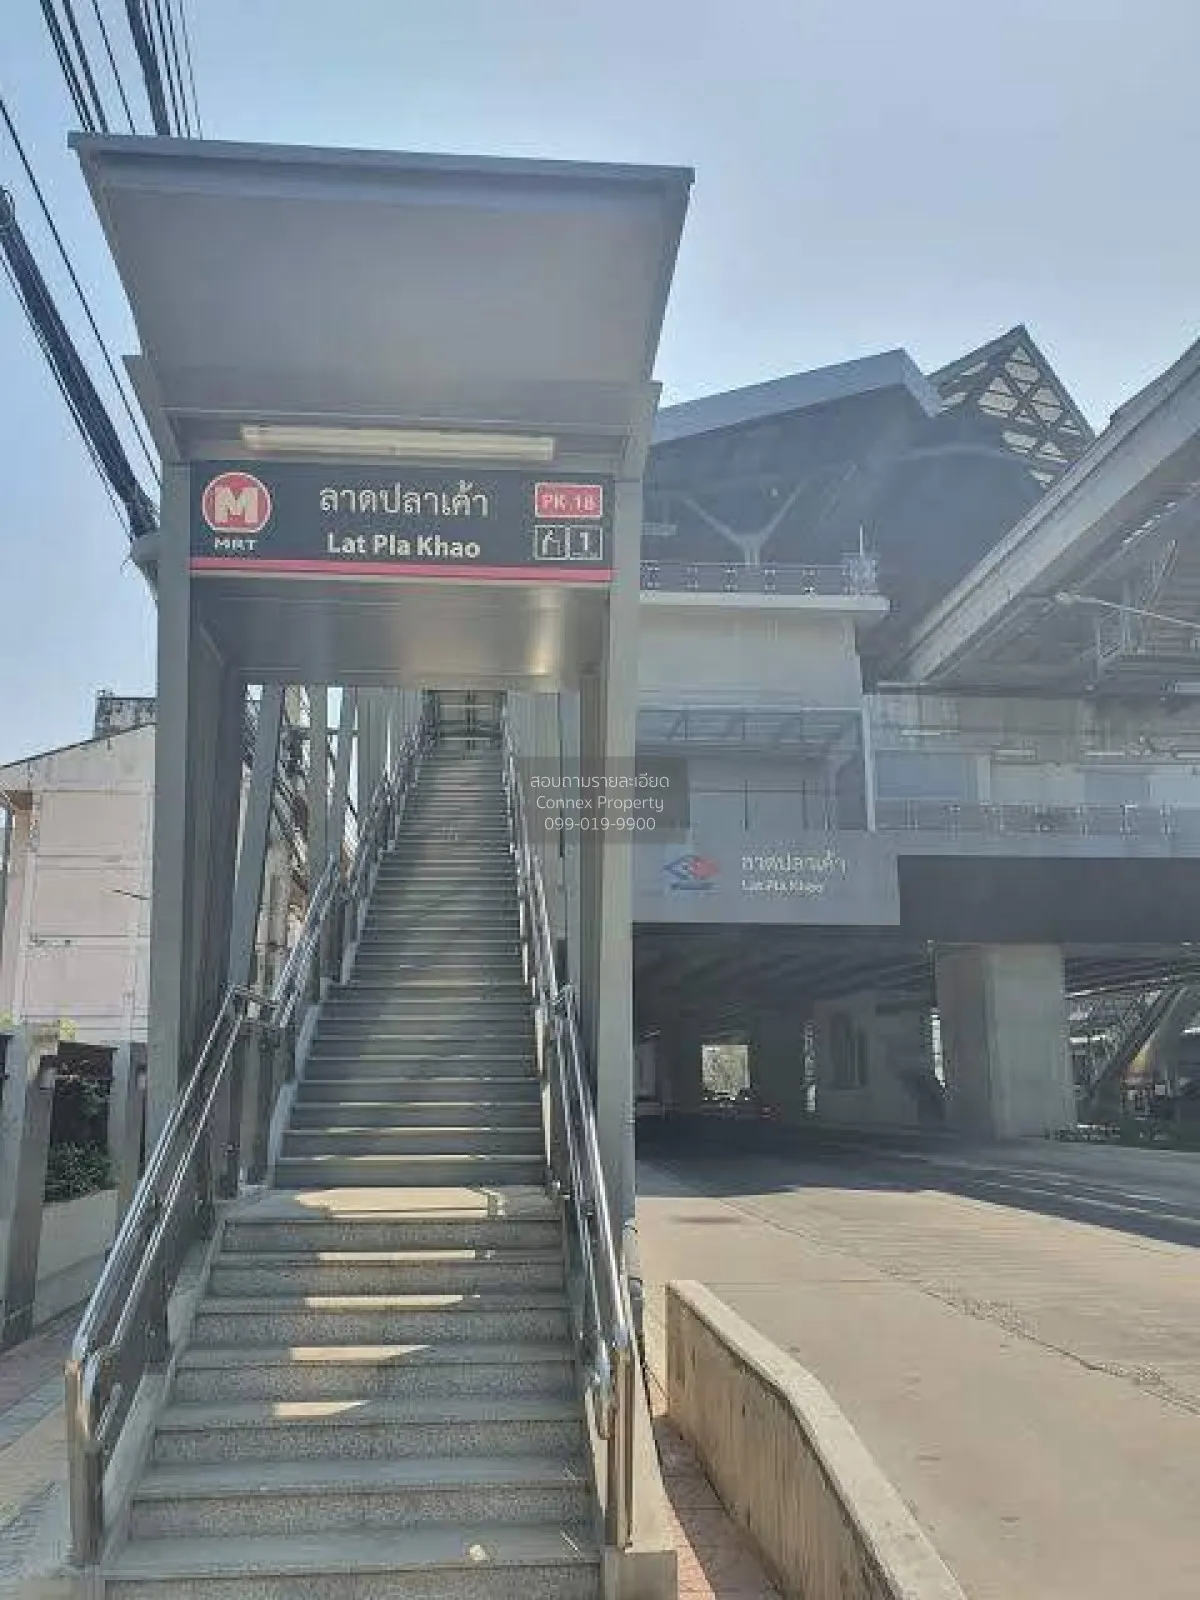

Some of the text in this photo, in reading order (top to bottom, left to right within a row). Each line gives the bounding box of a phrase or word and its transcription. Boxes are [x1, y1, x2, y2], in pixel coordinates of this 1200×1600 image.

[327, 532, 481, 558] Lat Pla Khao
